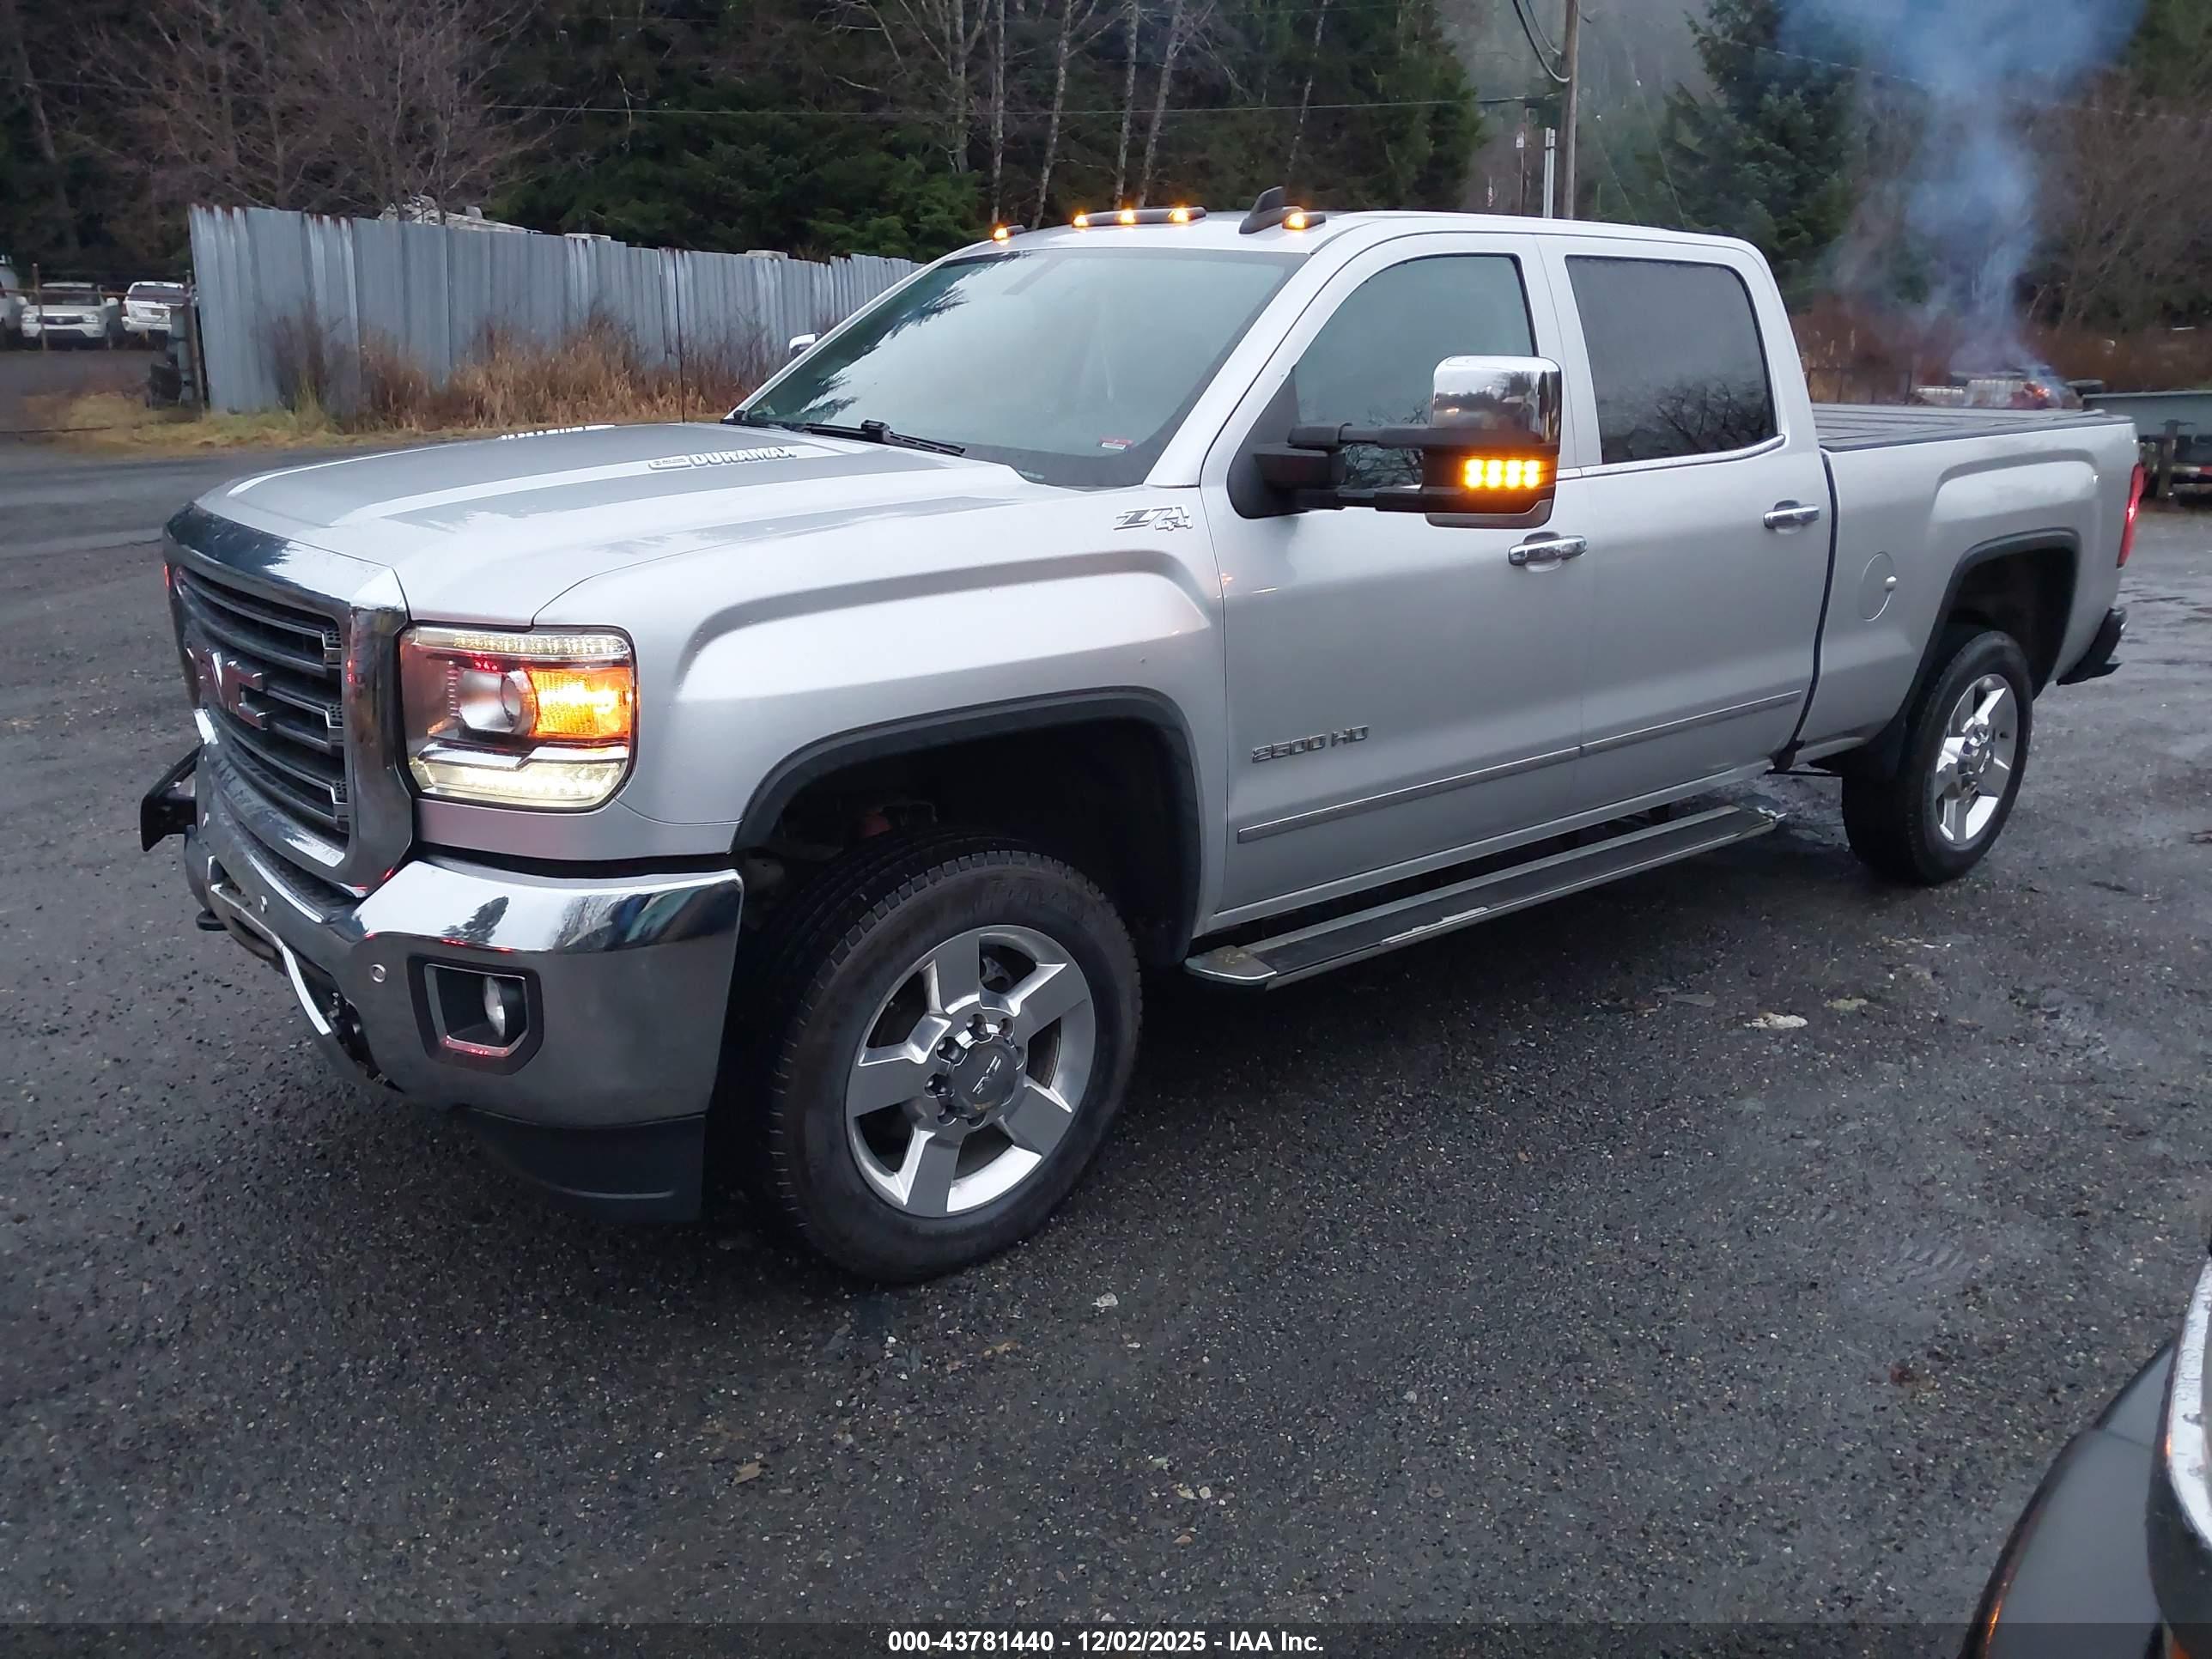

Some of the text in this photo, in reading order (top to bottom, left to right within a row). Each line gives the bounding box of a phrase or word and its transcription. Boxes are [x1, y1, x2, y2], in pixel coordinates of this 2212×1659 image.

[689, 446, 796, 466] DURAMAX
[1113, 505, 1190, 530] Z71
[1251, 725, 1370, 763] 2500 HD
